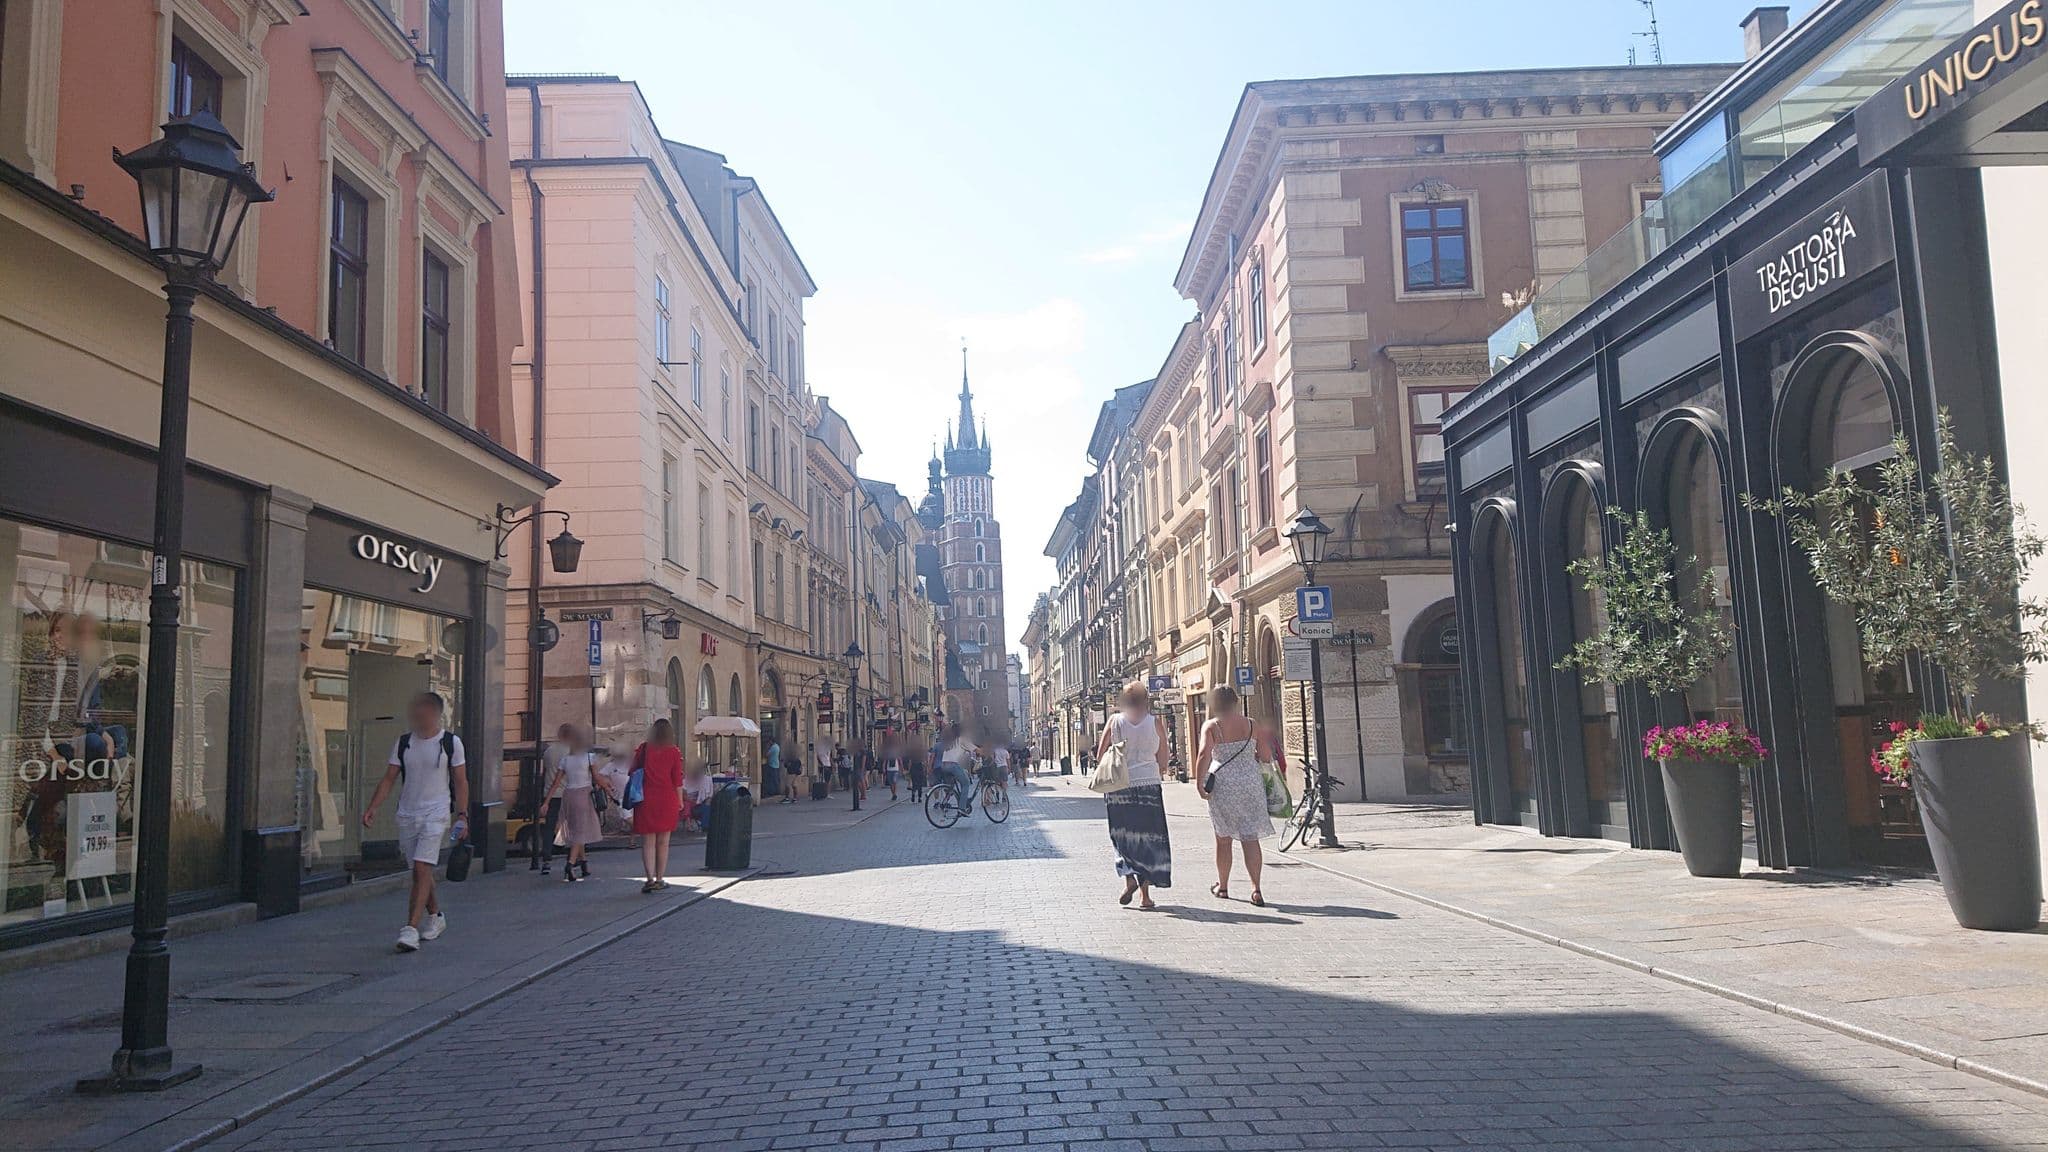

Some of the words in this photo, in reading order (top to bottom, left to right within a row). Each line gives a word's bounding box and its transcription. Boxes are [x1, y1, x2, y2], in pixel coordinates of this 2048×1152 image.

[1905, 0, 2045, 119] UNICUS
[1757, 211, 1857, 291] TRATTORIA
[1304, 591, 1325, 618] P
[1302, 627, 1331, 635] Koniec
[1239, 669, 1249, 683] P
[19, 758, 132, 793] orsay
